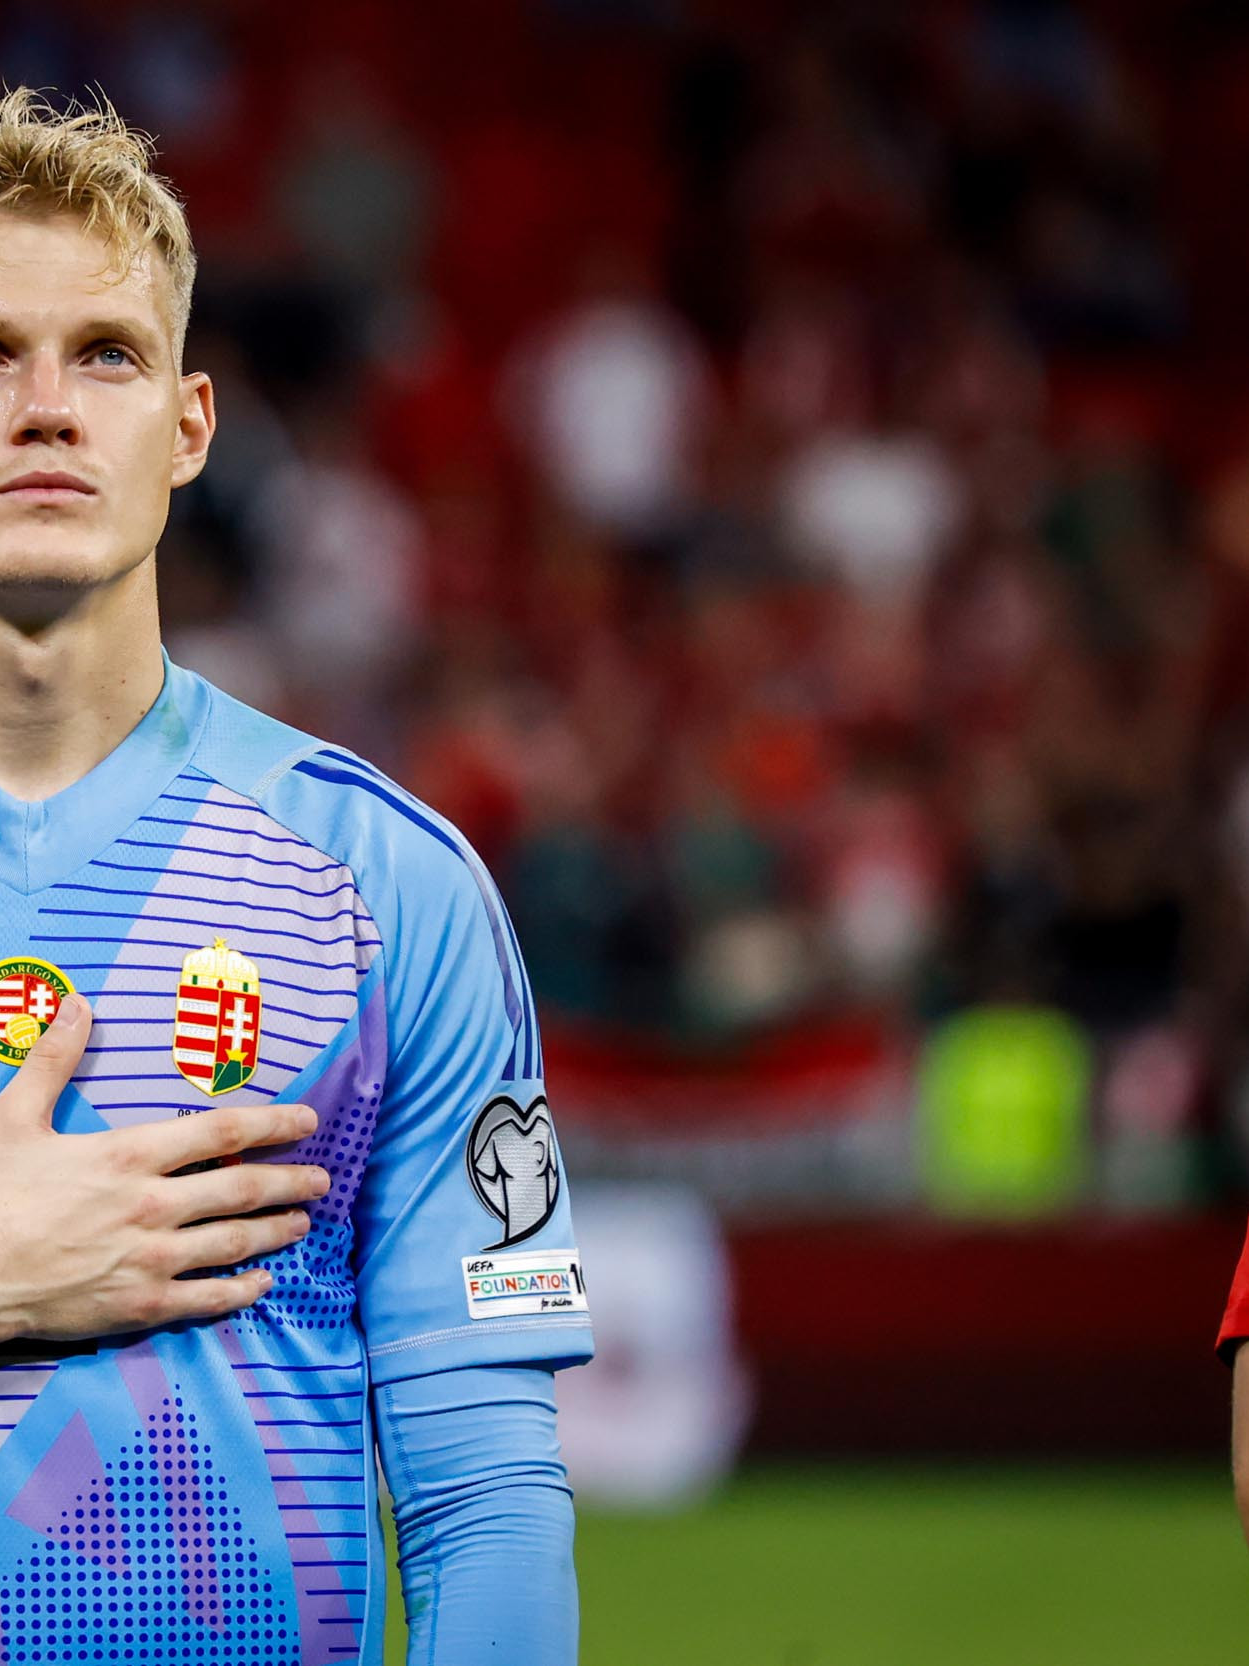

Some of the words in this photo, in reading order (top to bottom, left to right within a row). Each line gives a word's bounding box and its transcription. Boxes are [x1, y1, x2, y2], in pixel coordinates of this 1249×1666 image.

[7, 1047, 30, 1059] 190
[467, 1261, 494, 1273] UEFA
[469, 1274, 570, 1296] FOUNDATION
